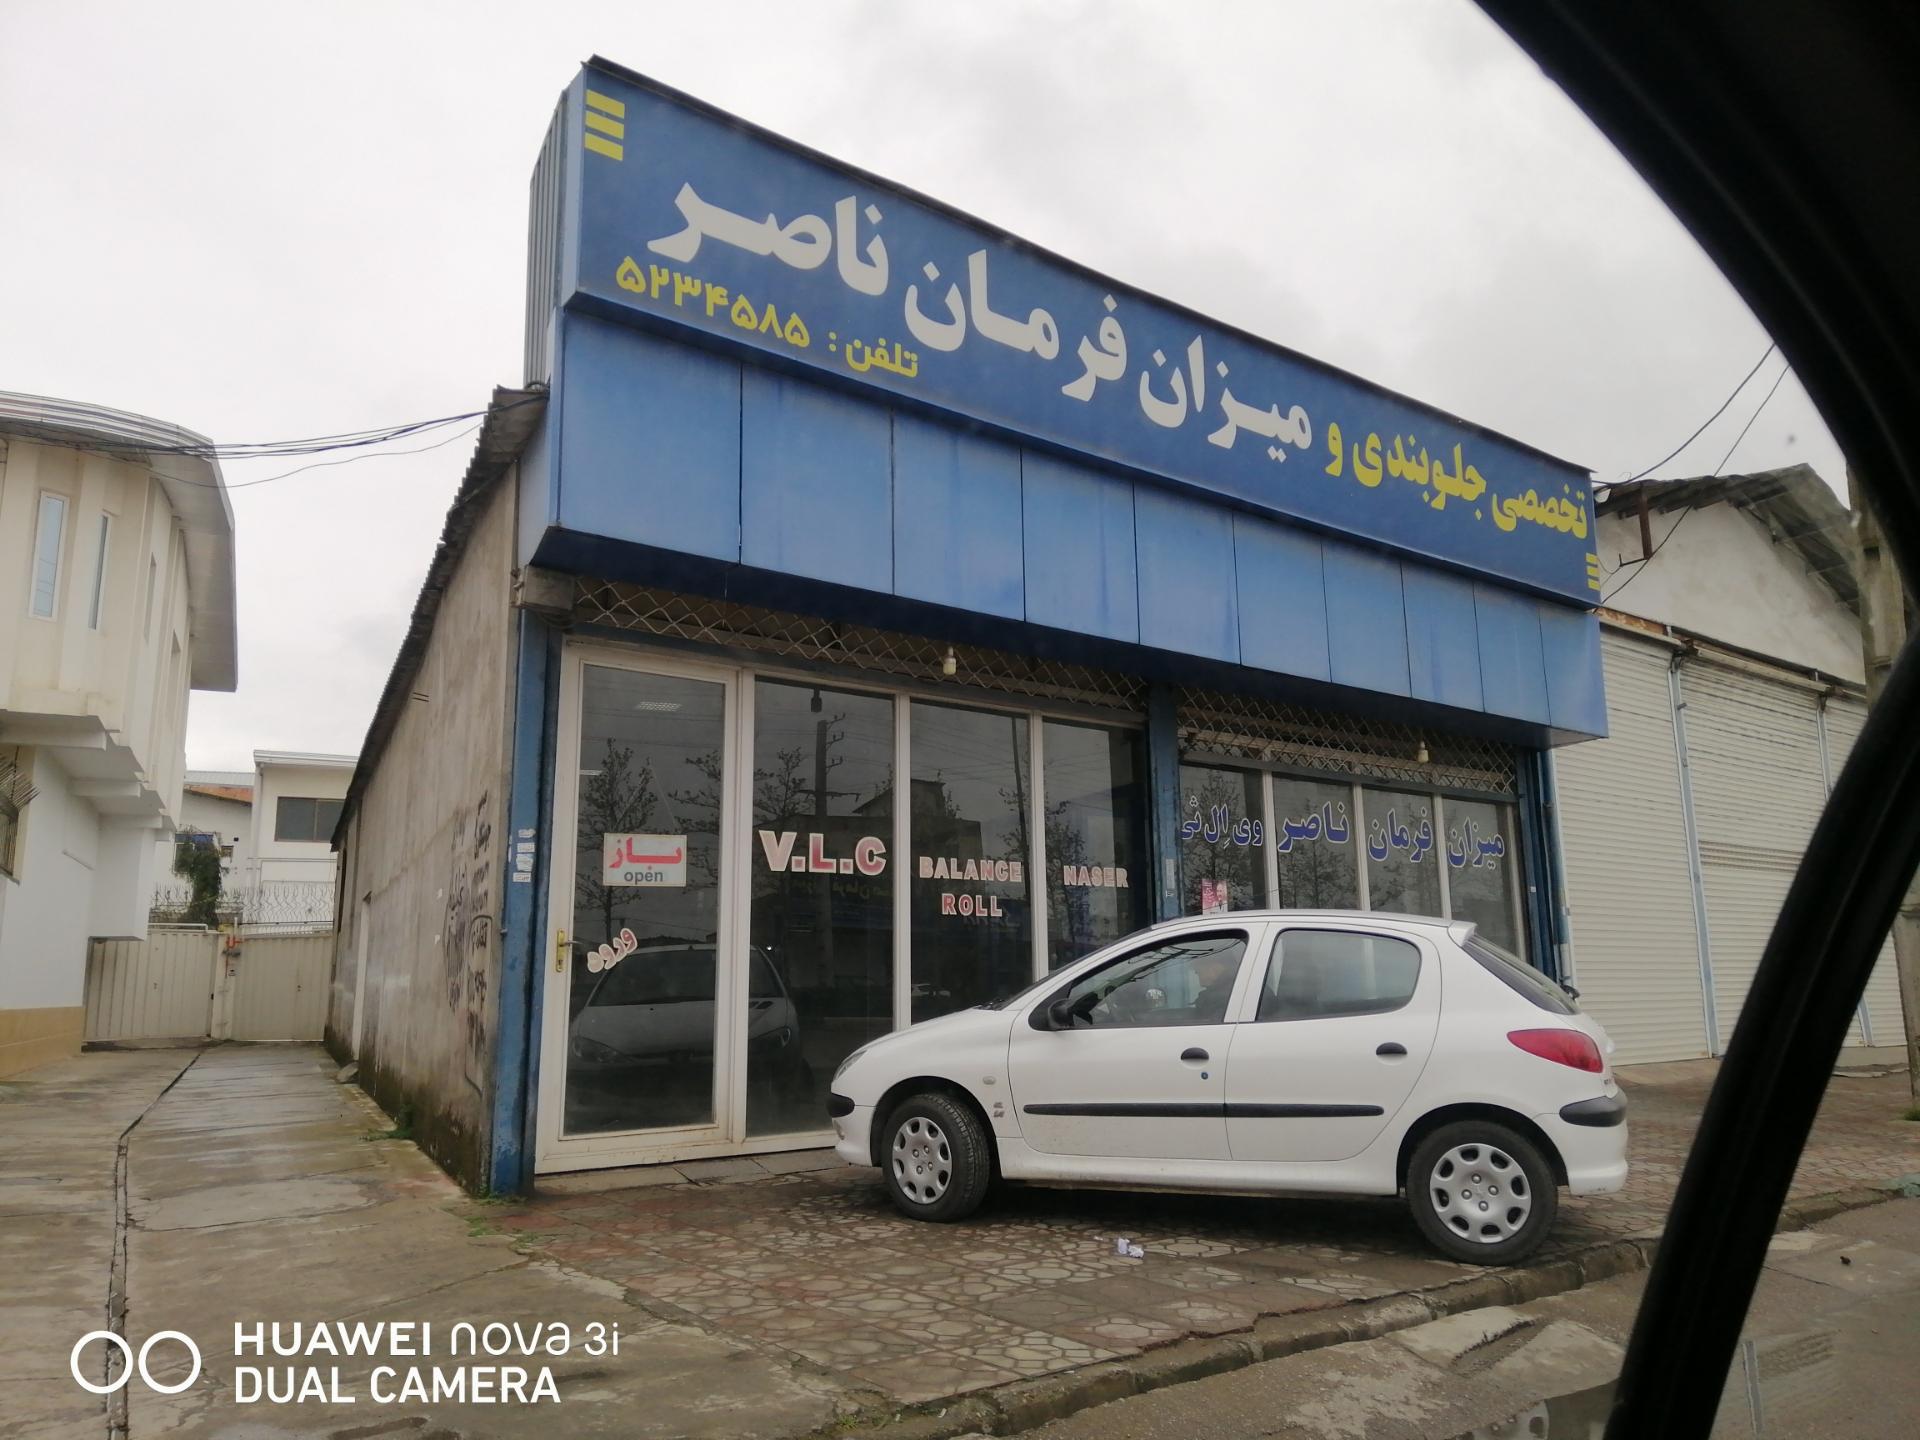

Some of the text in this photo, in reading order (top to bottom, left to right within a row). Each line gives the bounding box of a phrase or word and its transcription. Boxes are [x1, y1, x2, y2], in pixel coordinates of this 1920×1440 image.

[615, 254, 811, 348] ۵۲۳۴۵۸۵
[647, 182, 1588, 540] تخصصی جلوبندی و میزان فرمان ناصر
[1277, 800, 1350, 853] ناصر
[1367, 806, 1434, 863] فرمان
[1448, 816, 1505, 869] میزان
[608, 836, 683, 871] باز
[758, 830, 887, 876] V.L.C
[919, 856, 1023, 883] BALANCE
[623, 870, 664, 885] open
[1063, 865, 1129, 888] NASER
[941, 893, 1003, 918] ROLL
[587, 928, 638, 974] ورود
